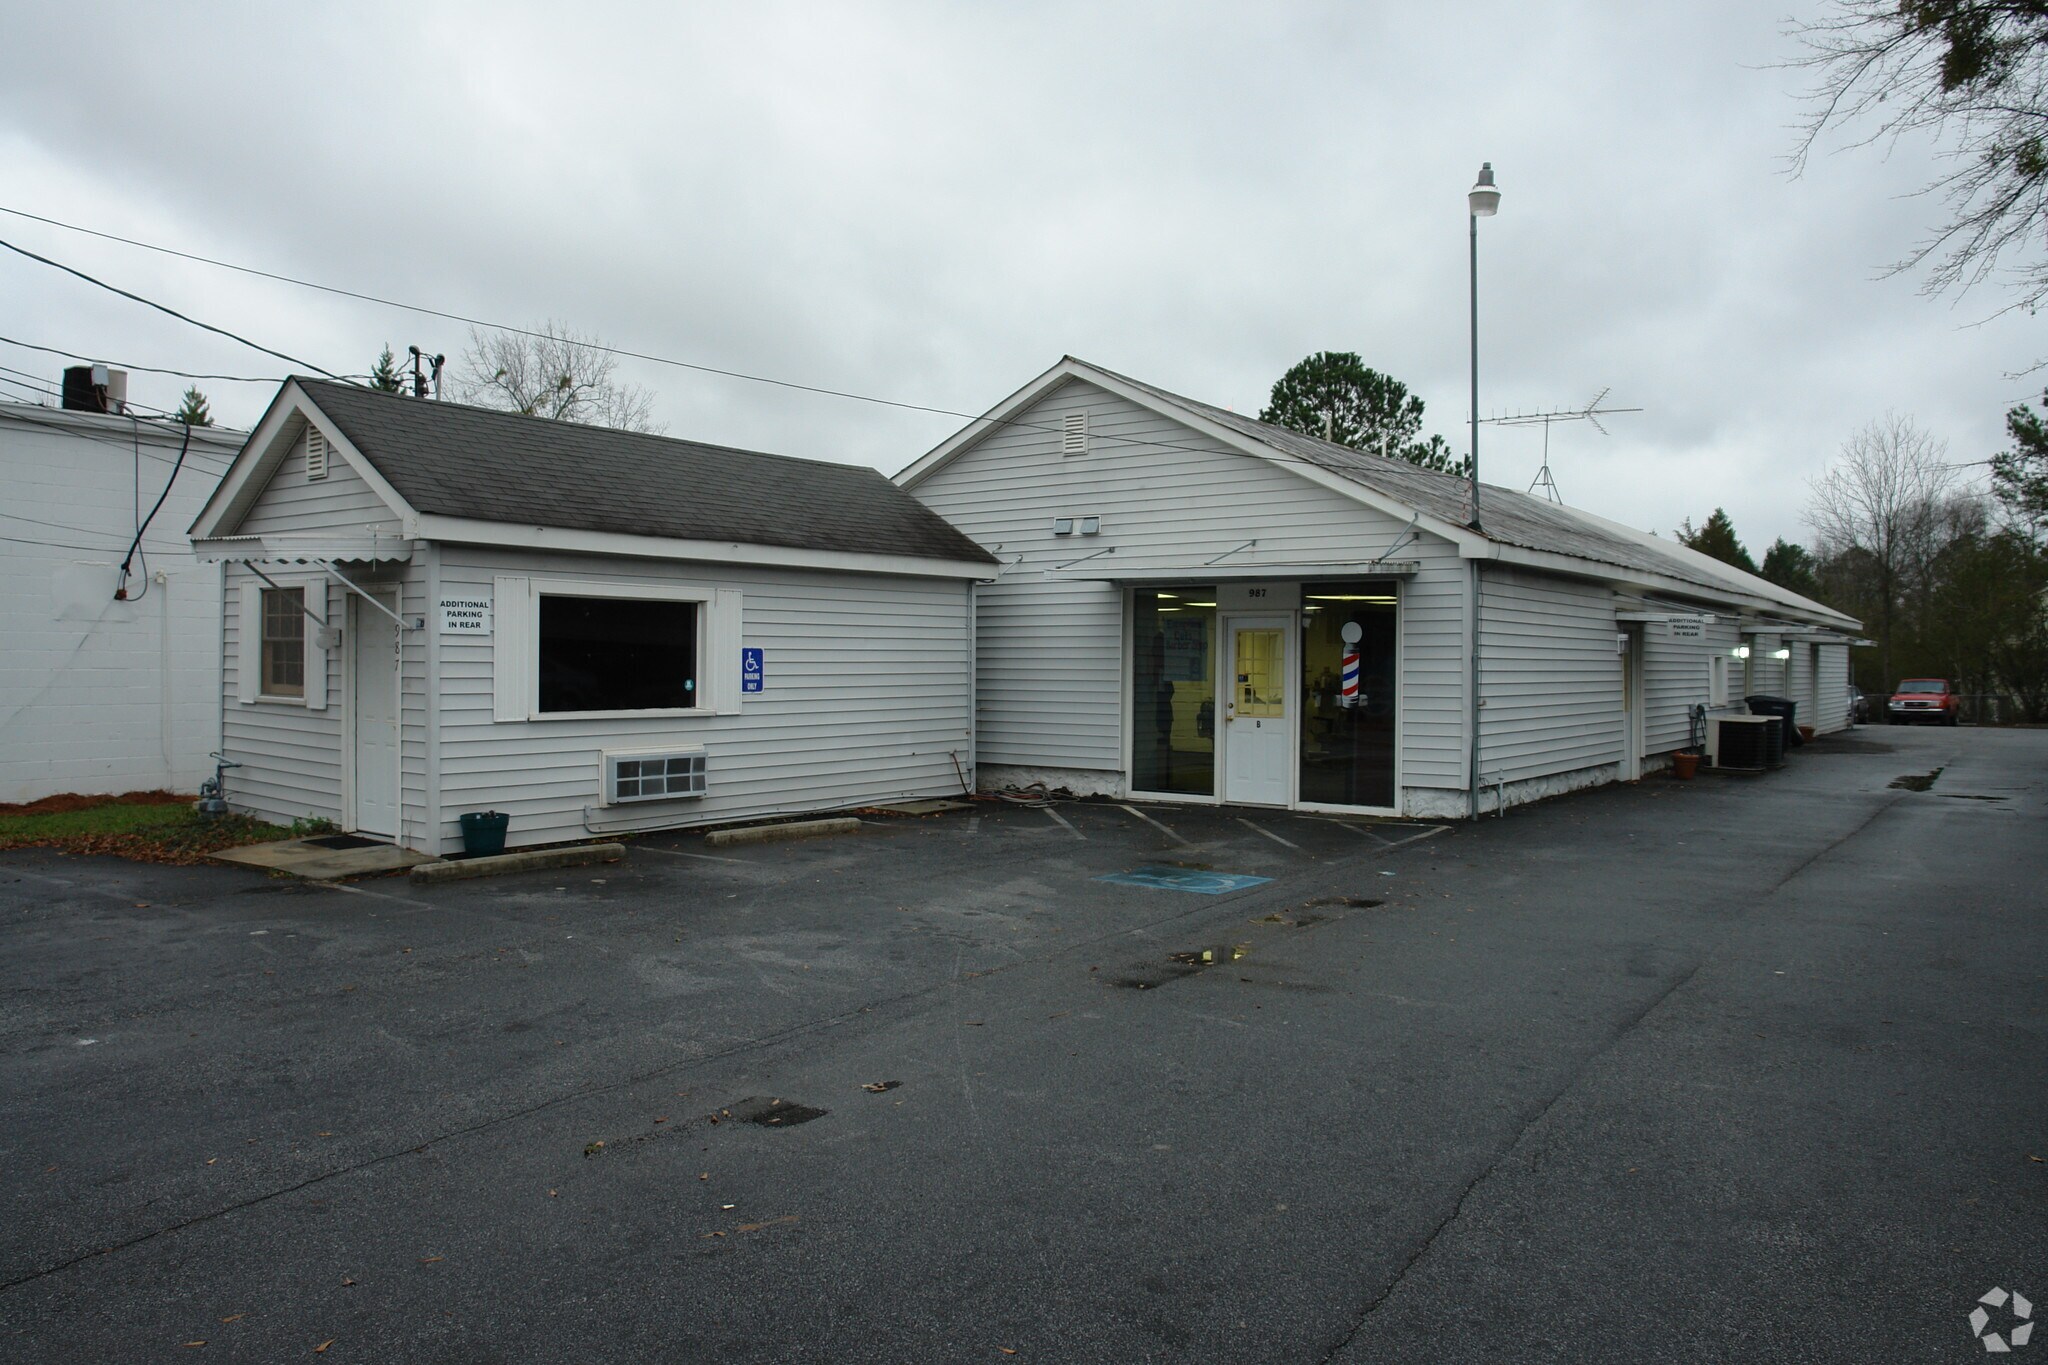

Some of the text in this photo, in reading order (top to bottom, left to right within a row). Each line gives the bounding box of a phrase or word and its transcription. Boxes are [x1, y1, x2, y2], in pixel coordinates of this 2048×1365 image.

[1249, 588, 1266, 598] 987
[440, 600, 489, 609] ADDITIONAL
[446, 610, 483, 618] PARKING
[459, 621, 481, 629] REAR
[744, 672, 760, 680] PARKING
[747, 682, 757, 690] ONLY
